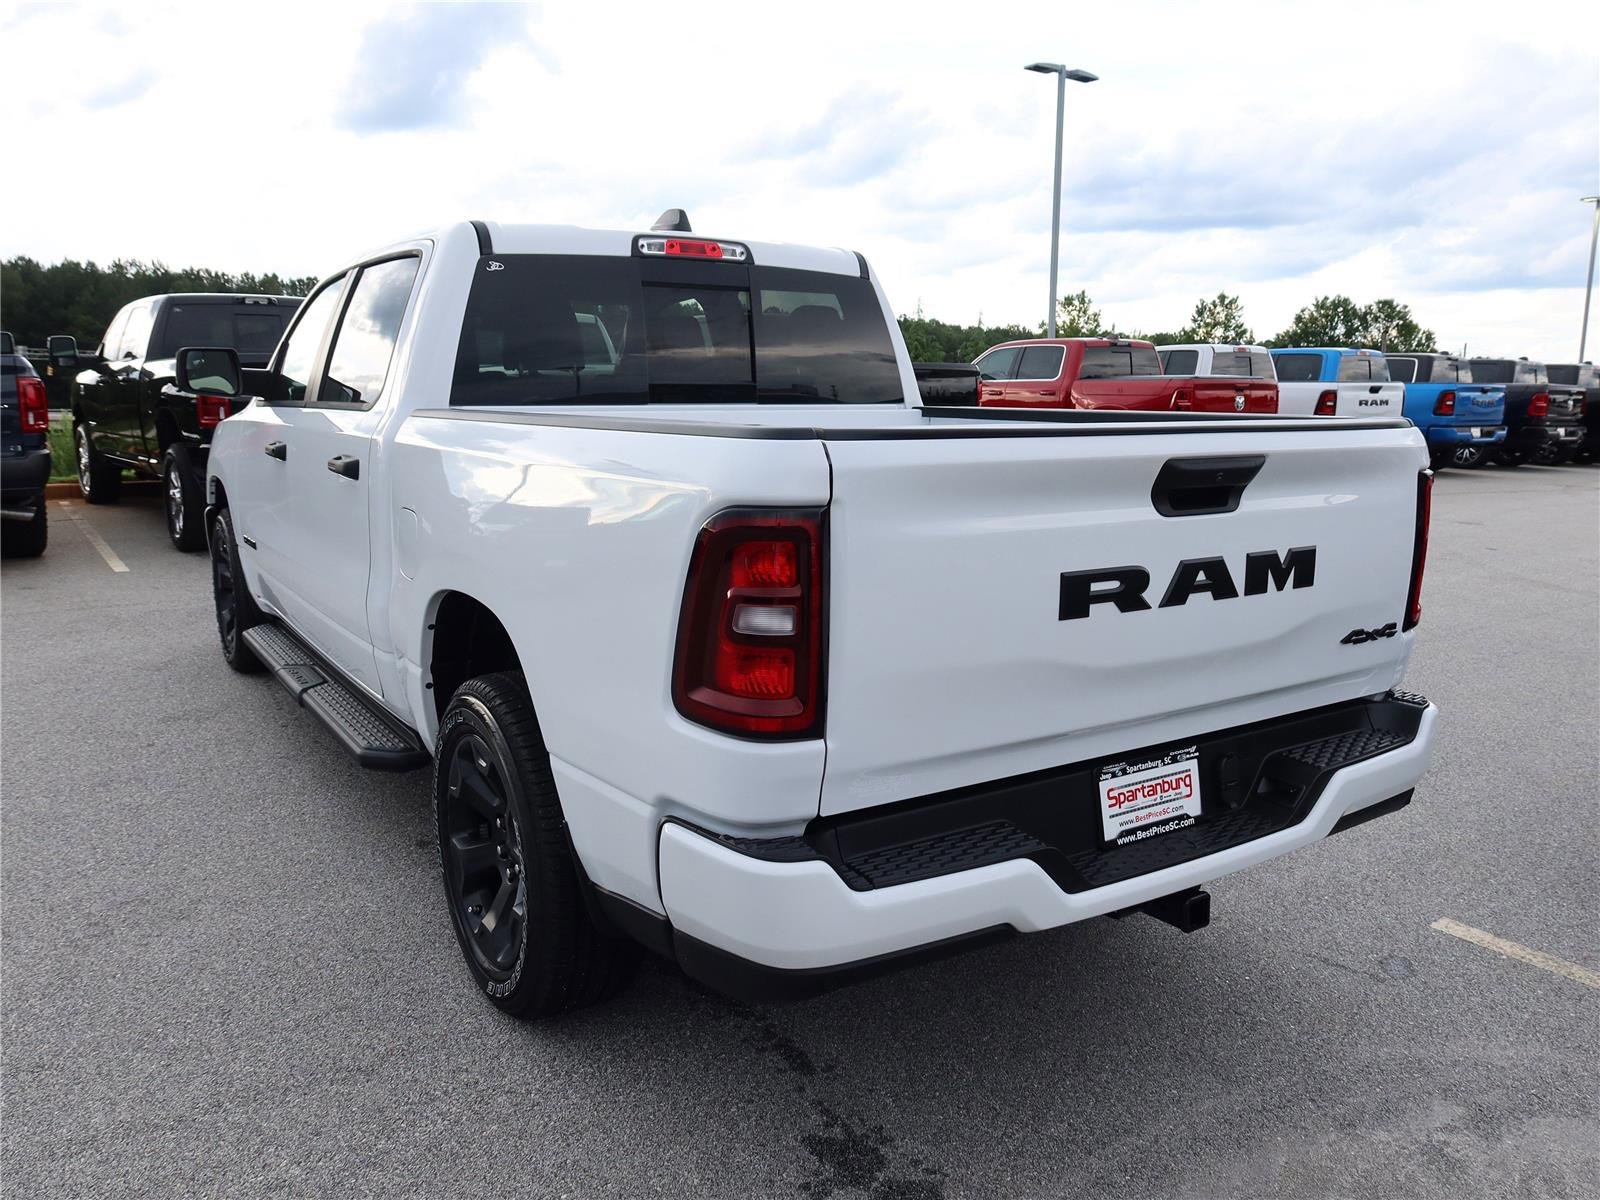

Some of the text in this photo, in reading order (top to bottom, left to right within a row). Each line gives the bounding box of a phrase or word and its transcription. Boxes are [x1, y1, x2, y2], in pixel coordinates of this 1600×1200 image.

[1359, 399, 1389, 407] RAM
[1058, 545, 1317, 621] RAM
[1126, 759, 1164, 775] Spartanburg,
[1164, 756, 1172, 765] SC
[1106, 773, 1193, 809] Spartanburg
[1118, 804, 1185, 828] www.BestPriceSC.com
[1116, 817, 1196, 846] www.BestPriceSC.com
